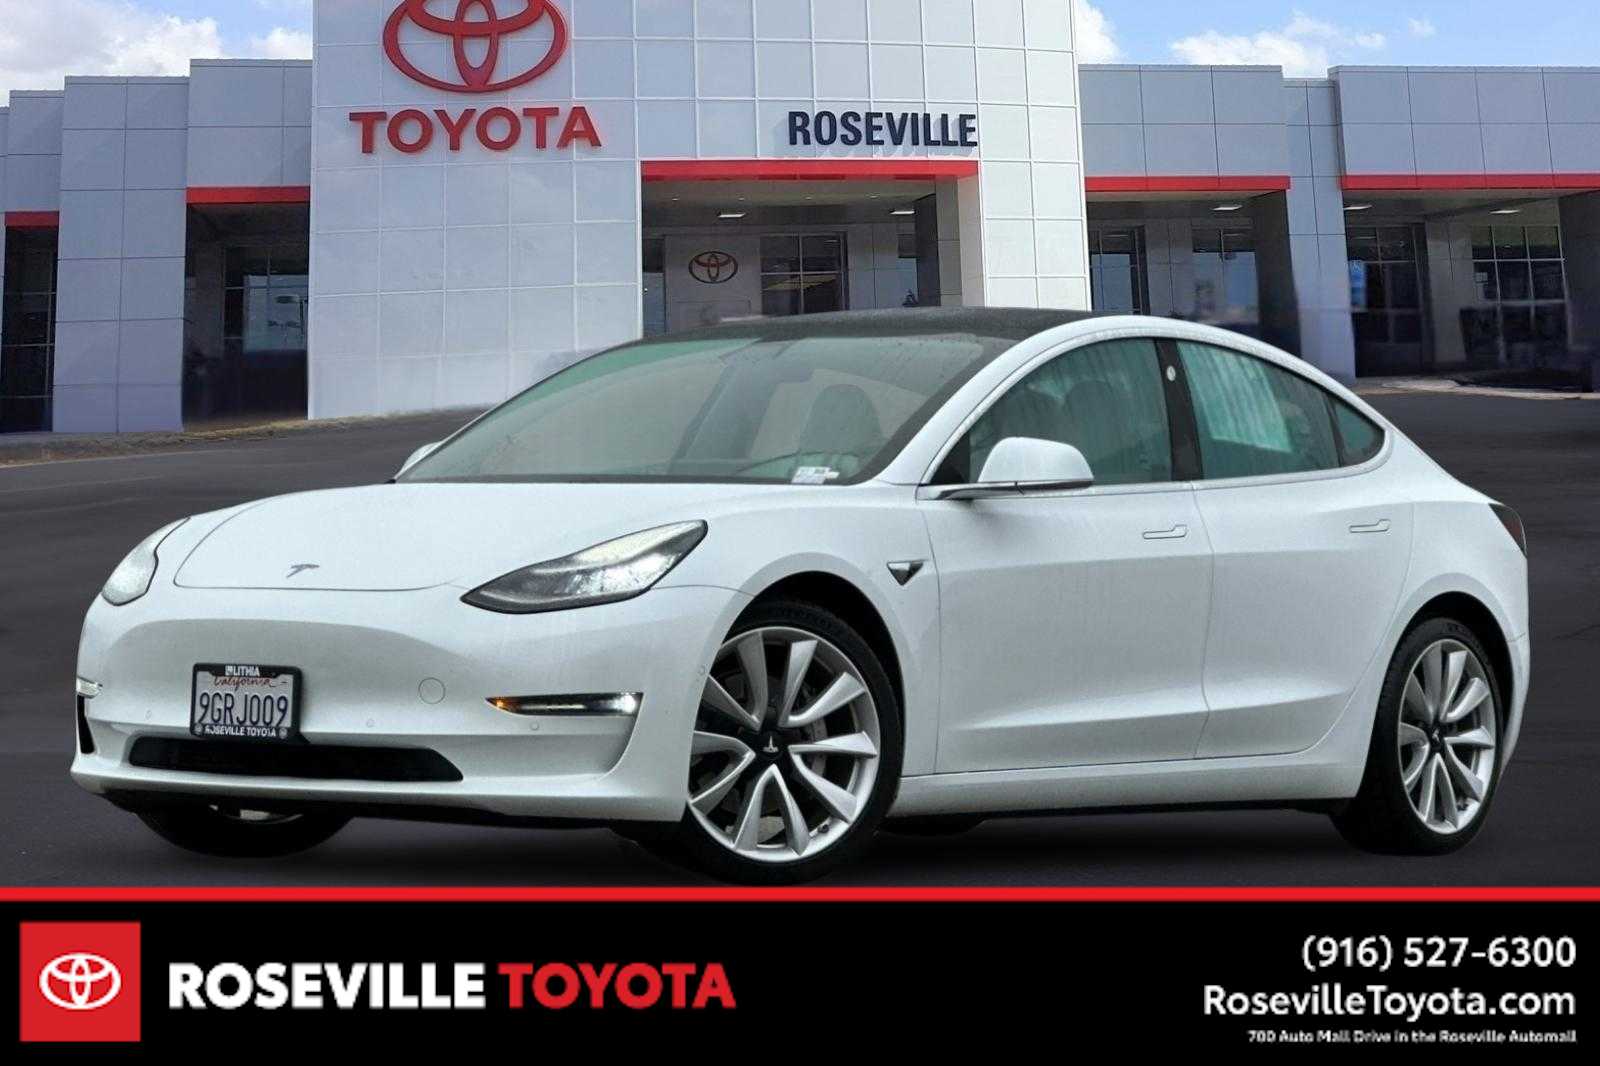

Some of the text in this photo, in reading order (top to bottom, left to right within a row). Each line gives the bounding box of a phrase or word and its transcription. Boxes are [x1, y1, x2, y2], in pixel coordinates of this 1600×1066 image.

[349, 106, 602, 154] TOYOTA
[788, 110, 978, 147] ROSEVILLE
[233, 665, 260, 677] LITHIA
[198, 692, 288, 727] 9GRJ009
[247, 727, 276, 737] TOYOTA
